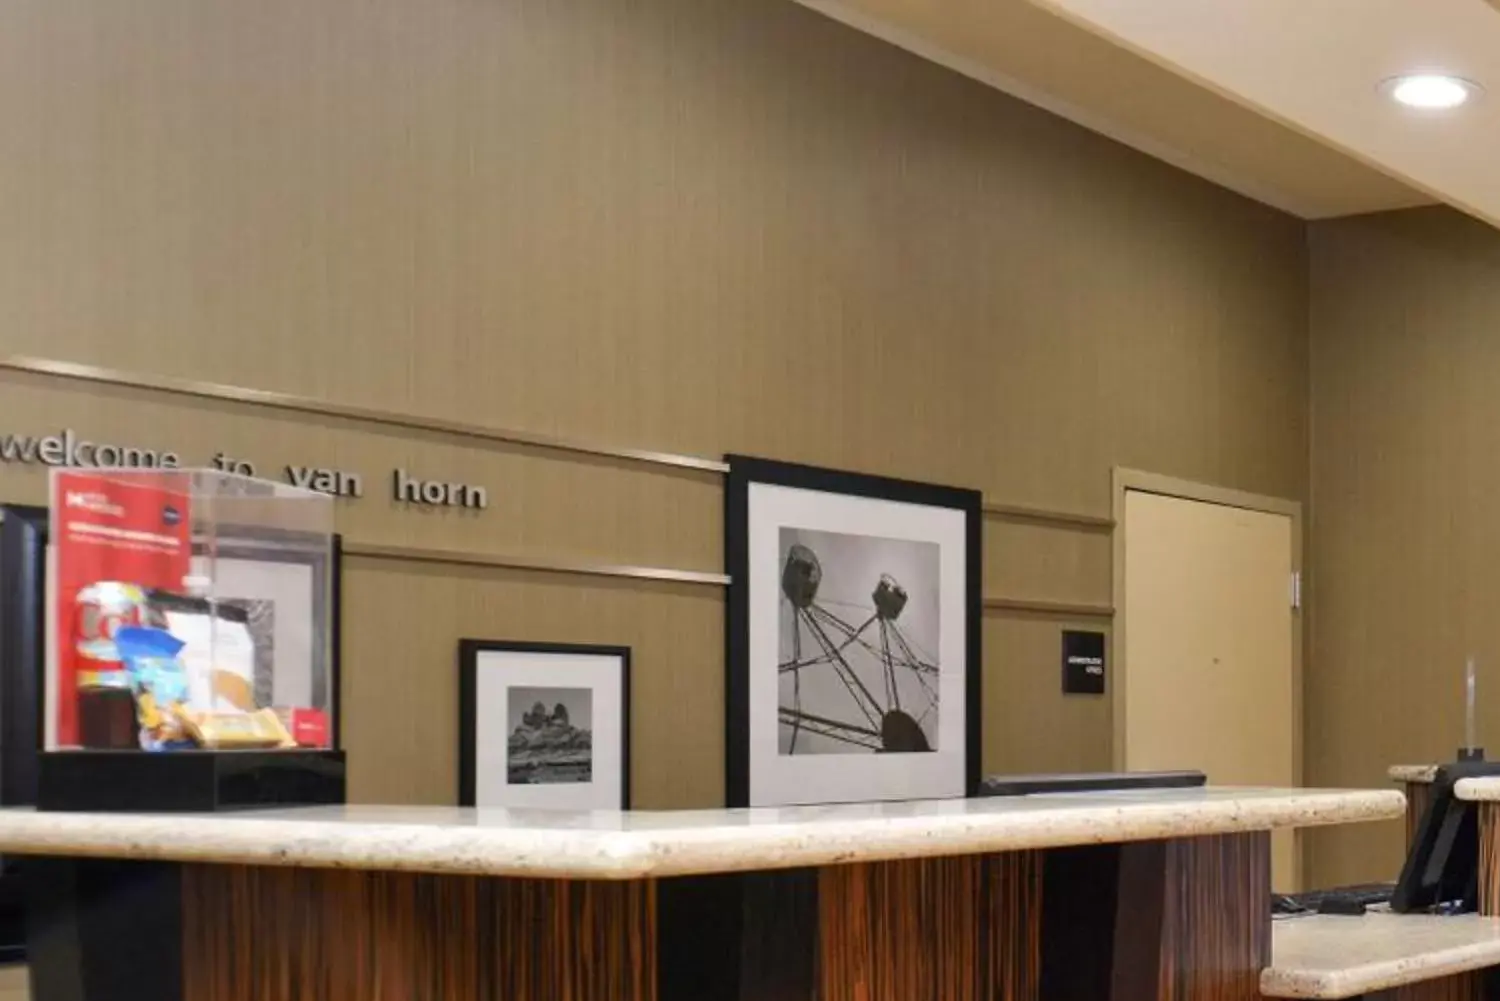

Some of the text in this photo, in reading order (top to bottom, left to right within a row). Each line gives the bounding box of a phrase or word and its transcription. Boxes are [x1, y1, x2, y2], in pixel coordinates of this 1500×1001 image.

[0, 428, 178, 468] welcome
[286, 465, 363, 497] van
[393, 468, 486, 508] horn
